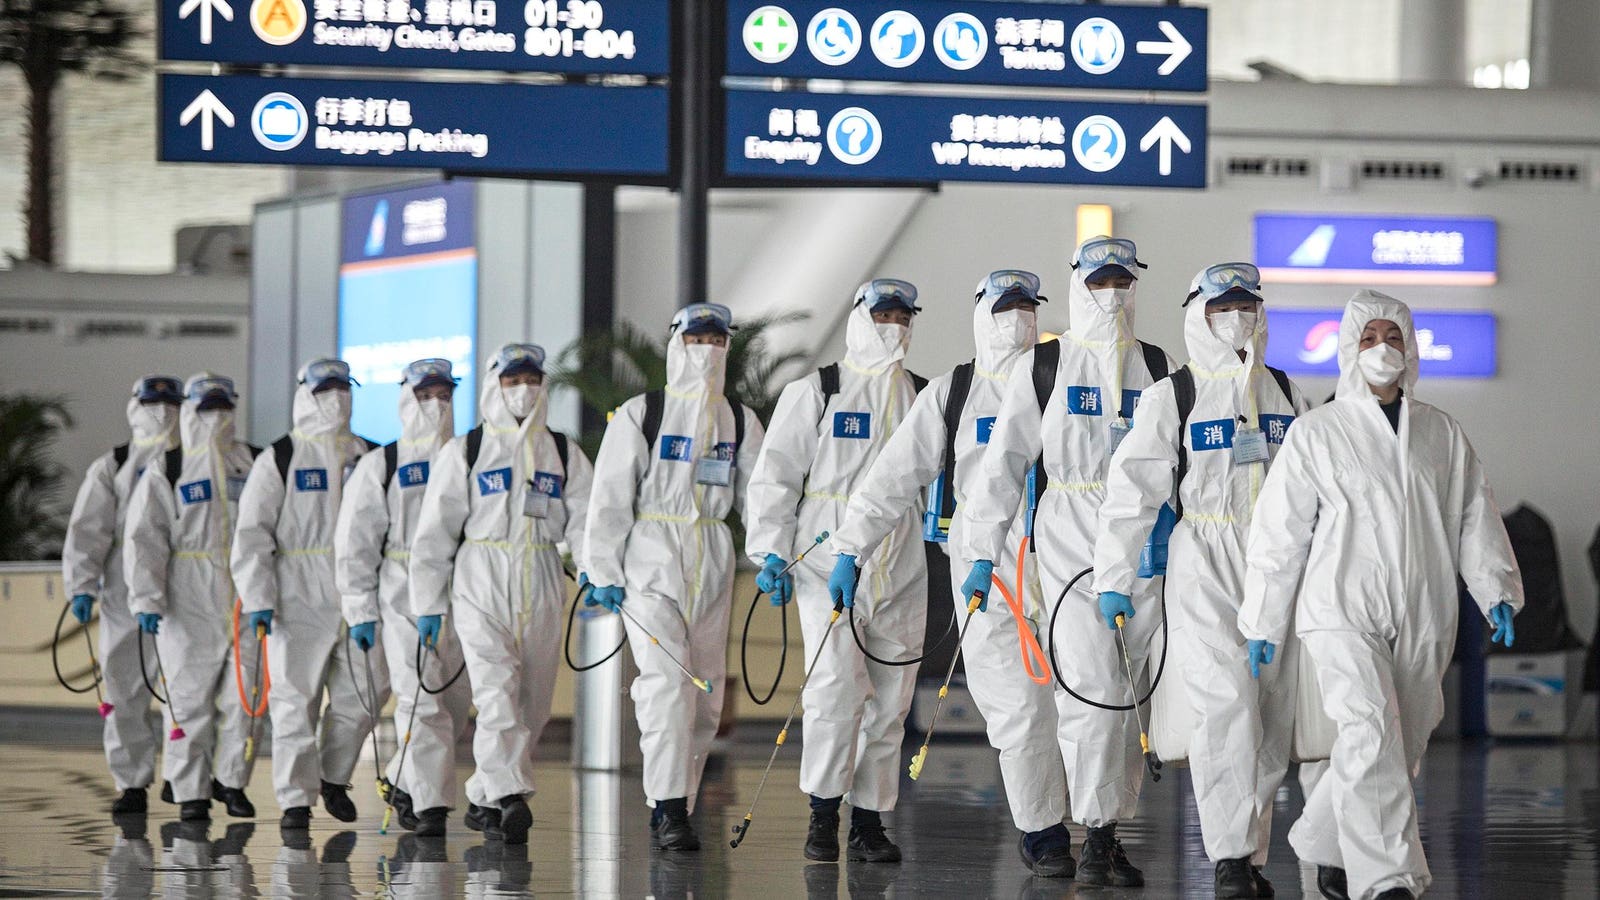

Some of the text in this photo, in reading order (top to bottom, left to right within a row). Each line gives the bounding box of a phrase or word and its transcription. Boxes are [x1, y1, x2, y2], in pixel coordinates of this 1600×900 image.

[313, 21, 394, 52] Security
[315, 126, 489, 158] Baggage Packing
[931, 141, 1067, 172] VIP Reception
[1080, 391, 1097, 412] 消
[844, 416, 860, 435] 消
[1204, 425, 1223, 446] 消
[1269, 419, 1286, 440] 防
[671, 440, 687, 458] 消
[407, 465, 422, 483] 消
